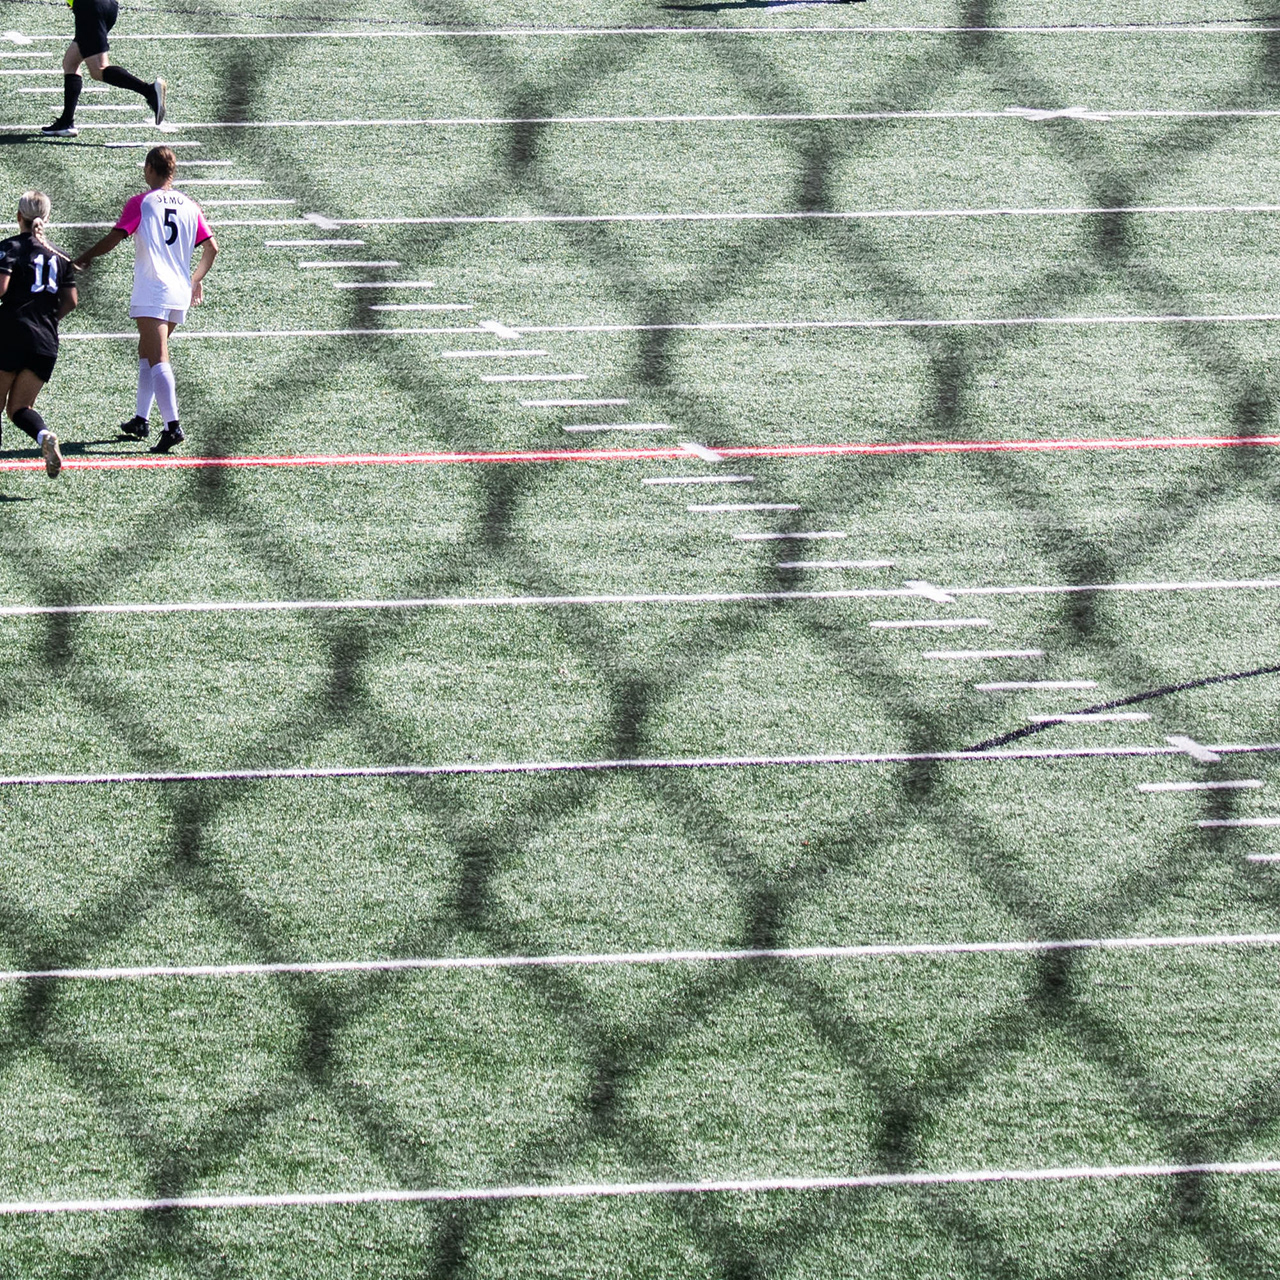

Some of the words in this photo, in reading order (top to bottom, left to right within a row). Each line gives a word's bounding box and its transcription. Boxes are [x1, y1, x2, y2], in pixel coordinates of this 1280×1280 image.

[156, 194, 184, 205] SEMO
[164, 208, 179, 246] 5
[30, 254, 58, 293] 11
